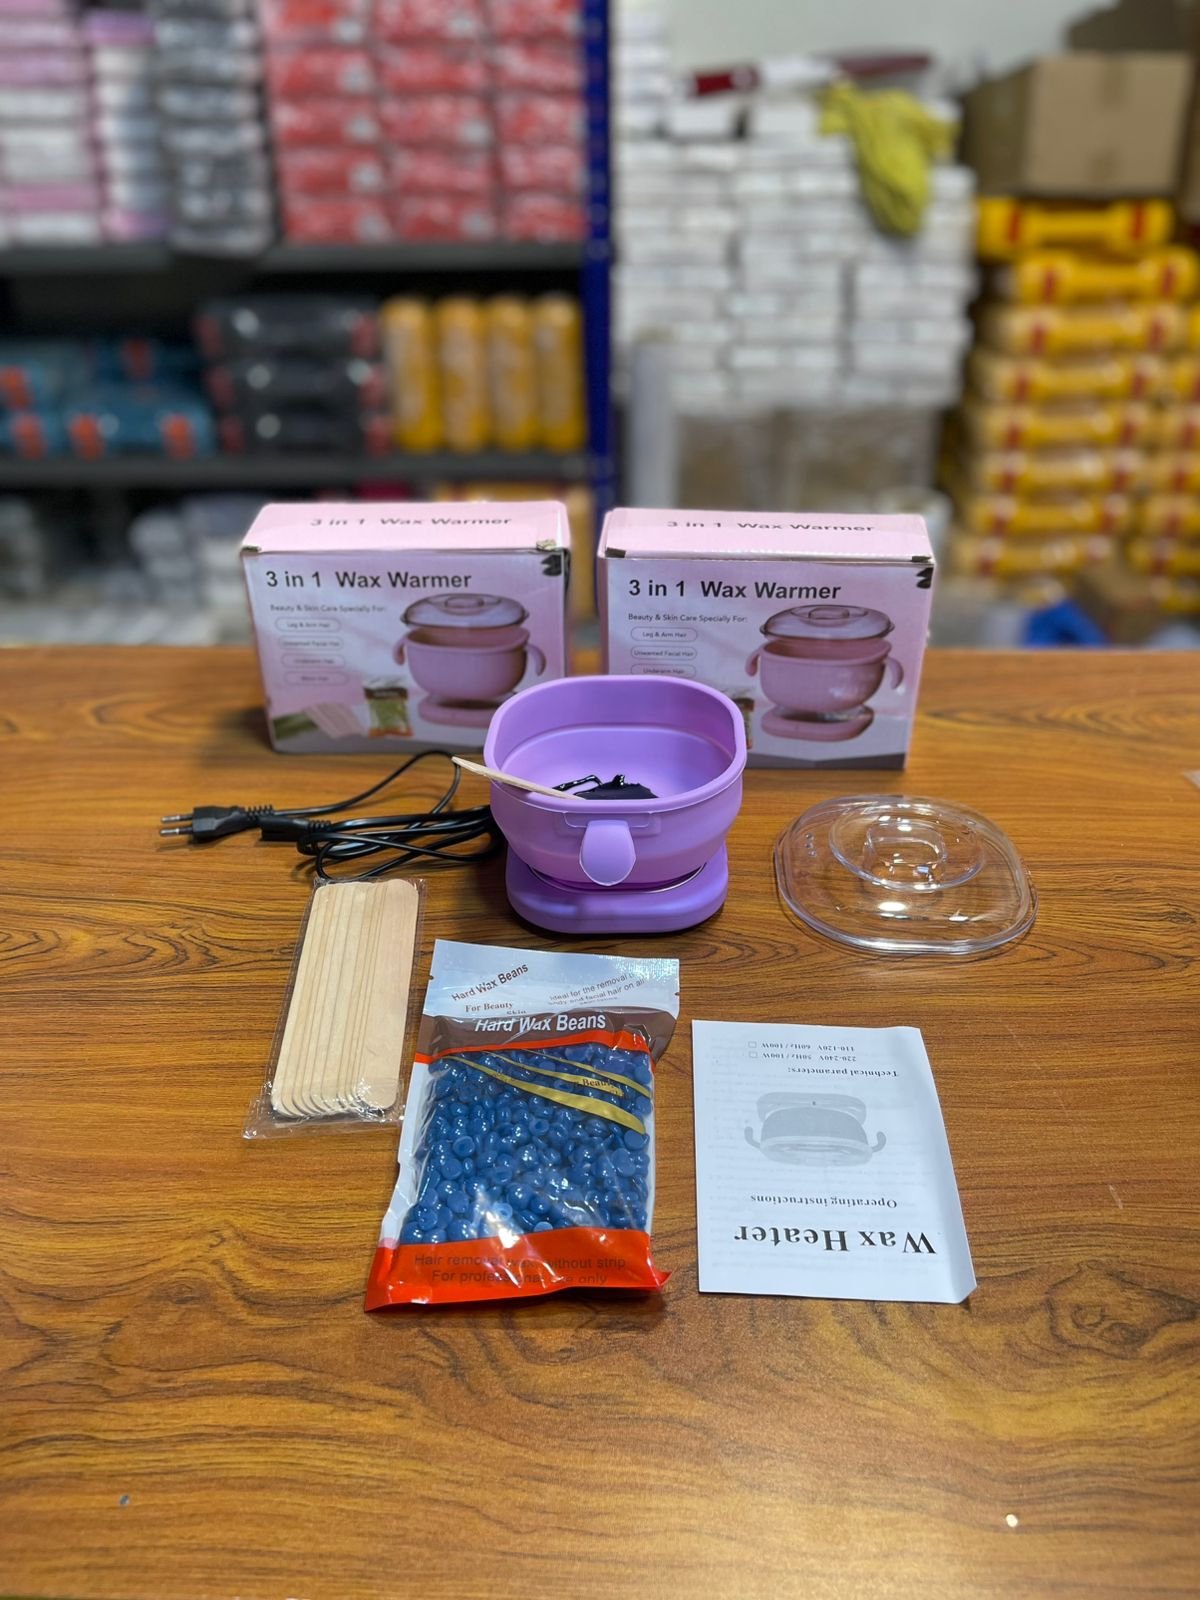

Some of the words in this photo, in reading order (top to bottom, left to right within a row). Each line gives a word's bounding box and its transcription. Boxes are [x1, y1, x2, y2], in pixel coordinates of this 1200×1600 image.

[310, 518, 322, 526] 3
[431, 517, 512, 525] Warmer
[790, 524, 875, 532] Warmer
[266, 571, 278, 588] 3
[285, 571, 304, 588] in
[312, 571, 320, 587] 1
[335, 571, 381, 588] Wax
[388, 571, 471, 588] Warmer
[629, 579, 640, 596] 3
[648, 580, 667, 597] in
[676, 580, 685, 597] 1
[701, 581, 746, 598] Wax
[755, 582, 841, 599] Warmer
[628, 613, 653, 622] Beauty
[663, 613, 678, 621] Skin
[680, 614, 696, 622] Care
[699, 615, 730, 624] Specially
[451, 988, 476, 1001] Hard
[476, 979, 498, 994] Wax
[498, 964, 529, 984] Beans
[570, 990, 581, 999] for
[582, 985, 595, 994] the
[596, 975, 627, 990] removal
[607, 986, 622, 996] hair
[624, 983, 634, 991] on
[636, 978, 646, 986] all
[465, 1004, 481, 1013] For
[484, 1002, 513, 1011] Beauty
[474, 1018, 513, 1032] Hard
[519, 1016, 552, 1032] Wax
[556, 1014, 606, 1031] Beans
[787, 1067, 848, 1076] parameters:
[850, 1068, 898, 1077] Technical
[750, 1195, 828, 1207] instructions
[831, 1196, 897, 1208] Operating
[734, 1226, 849, 1252] Heater
[858, 1231, 937, 1255] Wax
[415, 1255, 441, 1265] Hair
[448, 1254, 503, 1266] removal
[596, 1257, 626, 1271] strip
[432, 1270, 455, 1282] For
[460, 1270, 543, 1284] professnal
[579, 1272, 608, 1285] only
